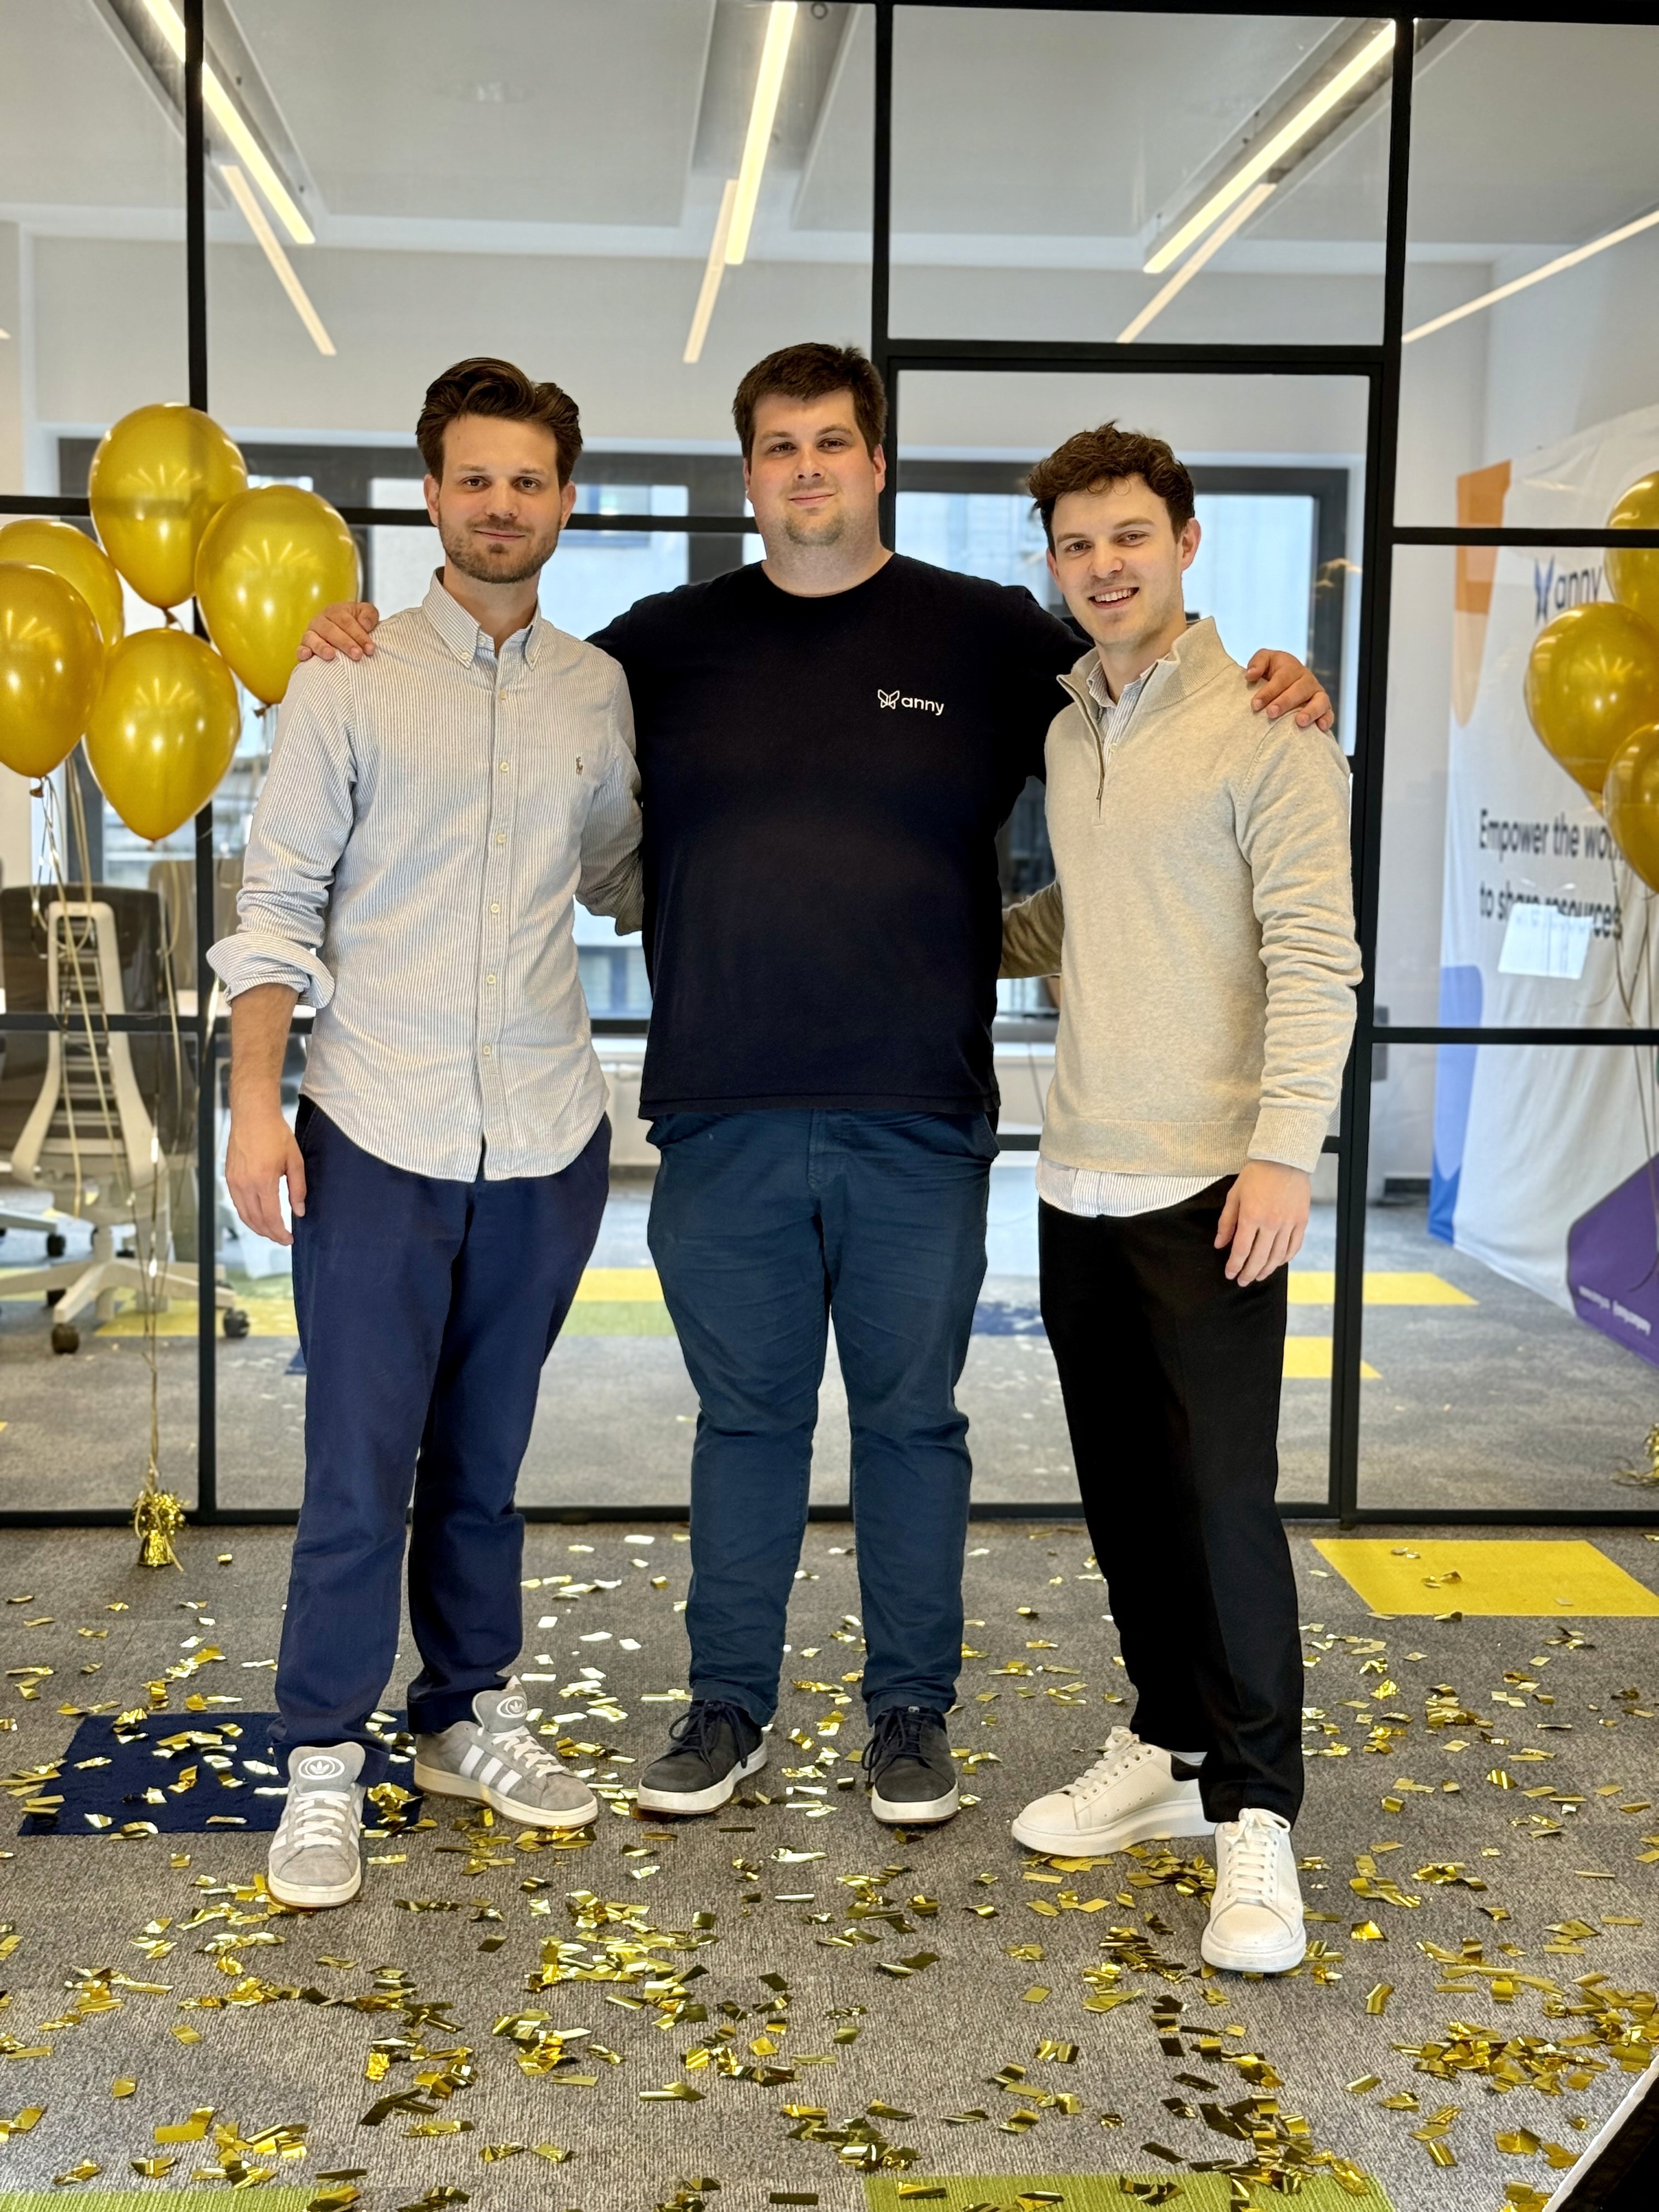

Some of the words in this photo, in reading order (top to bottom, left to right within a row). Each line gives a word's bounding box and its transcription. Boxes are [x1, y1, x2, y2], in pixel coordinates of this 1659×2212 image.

[1554, 565, 1602, 610] anny
[901, 697, 944, 716] anny
[1480, 808, 1548, 863] Empower
[1553, 811, 1579, 857] the
[1480, 881, 1493, 918] to
